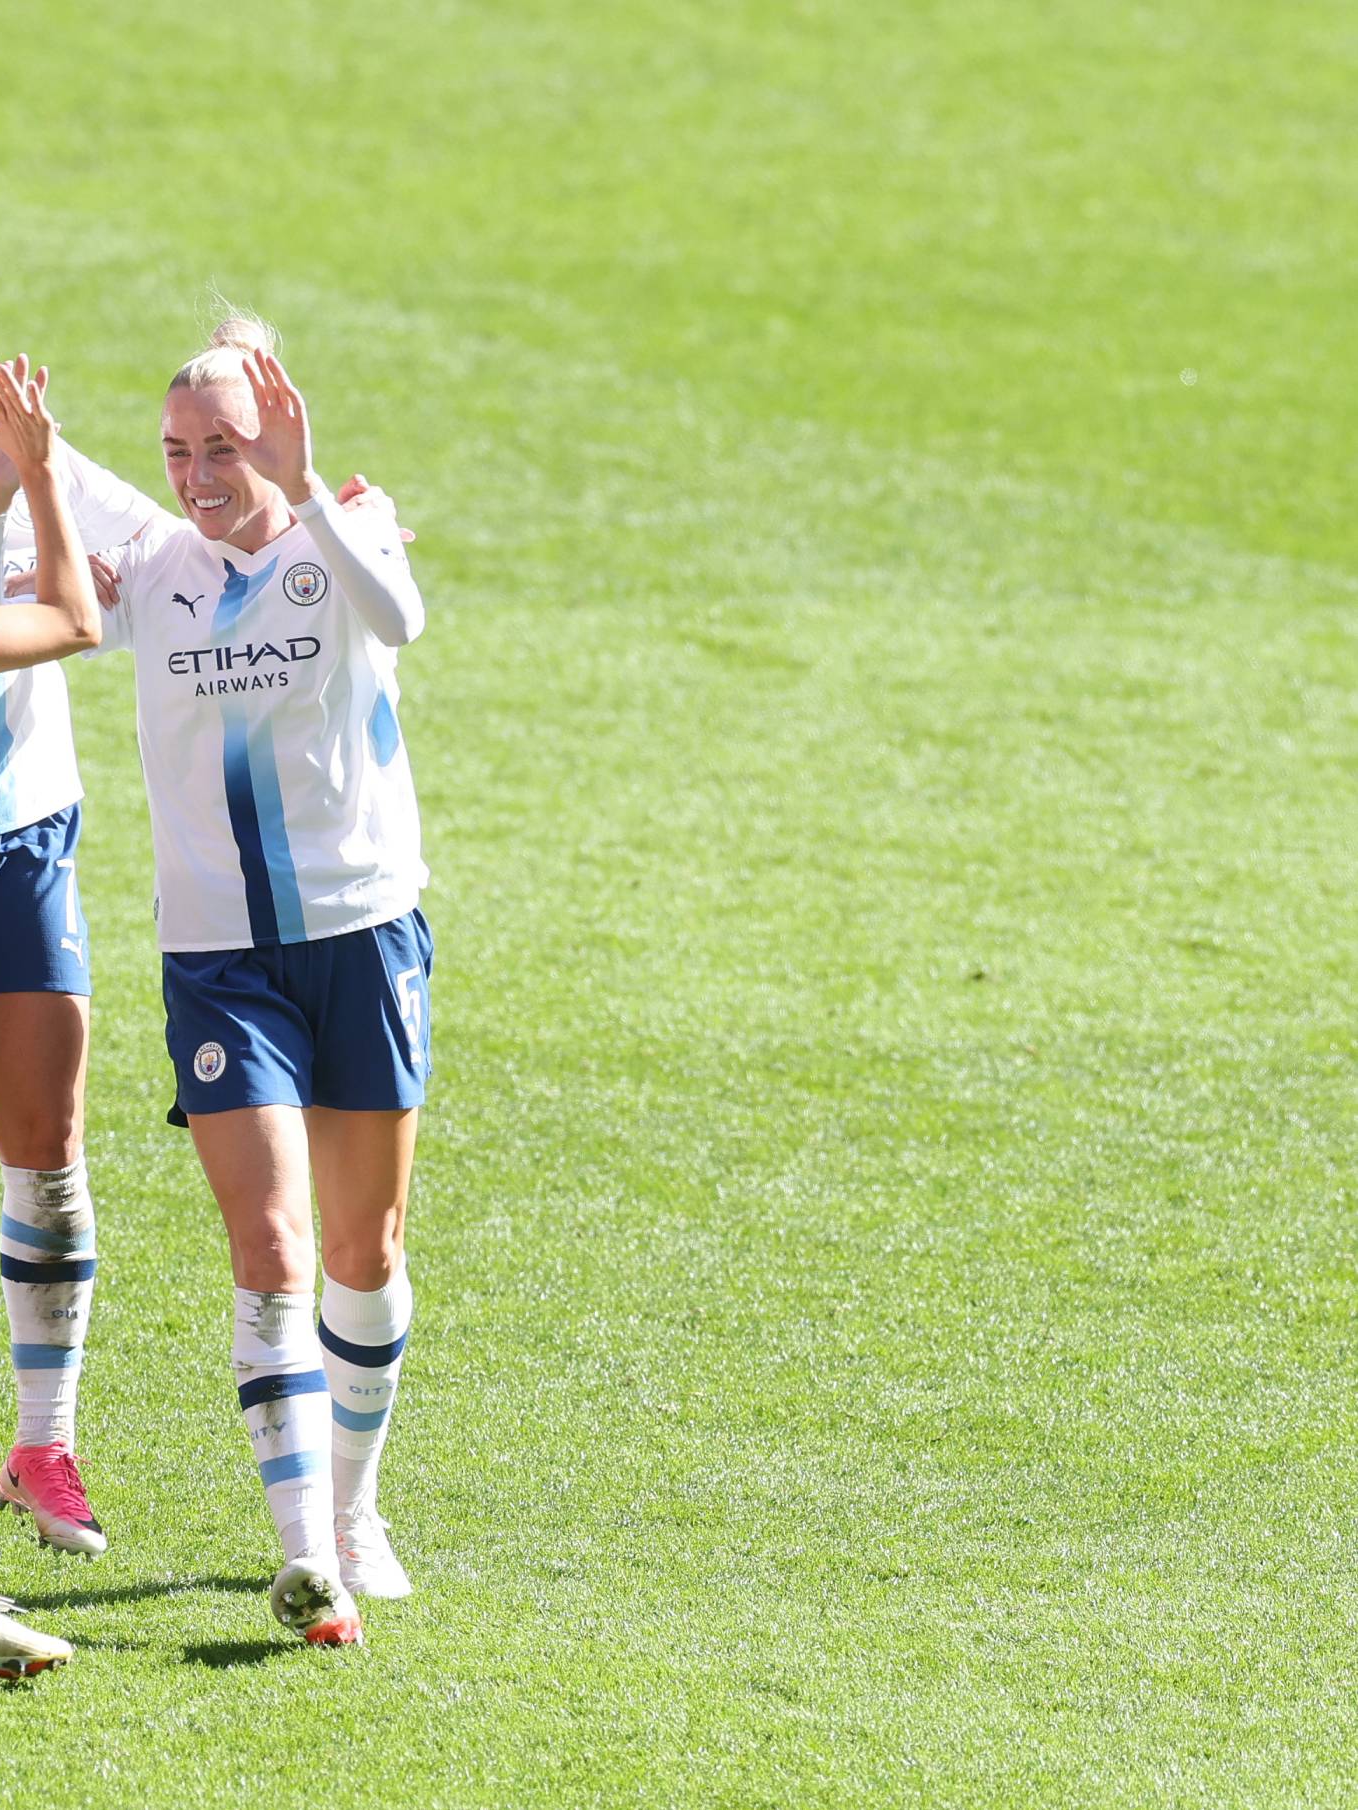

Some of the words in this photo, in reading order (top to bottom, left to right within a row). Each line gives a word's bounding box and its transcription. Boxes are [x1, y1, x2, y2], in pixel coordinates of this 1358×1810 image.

[286, 564, 322, 582] MANCHESTER
[168, 636, 321, 675] ETIHAD
[195, 671, 289, 697] AIRWAYS
